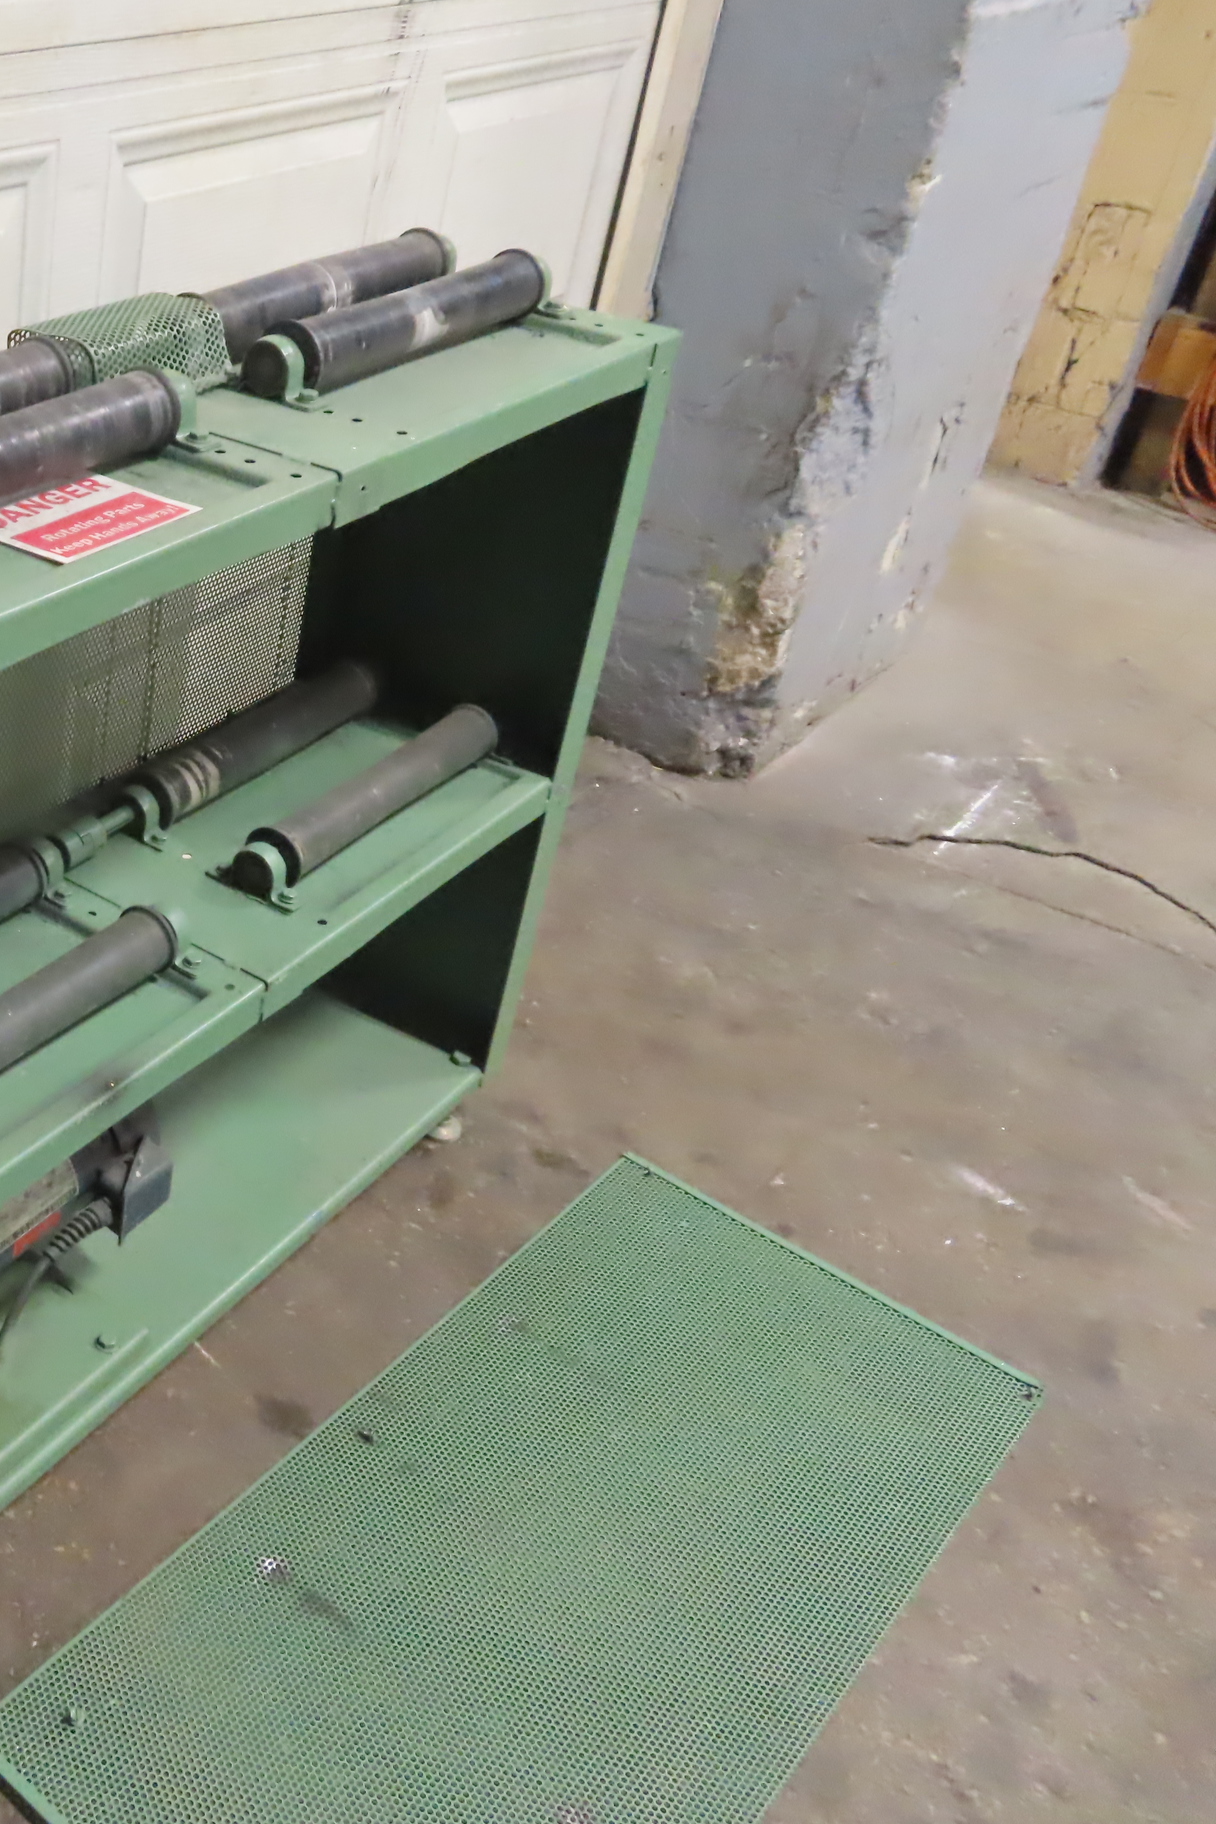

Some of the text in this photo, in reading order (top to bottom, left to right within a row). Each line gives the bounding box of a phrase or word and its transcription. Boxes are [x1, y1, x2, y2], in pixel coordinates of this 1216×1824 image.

[41, 501, 145, 542] Rotating Parts
[50, 504, 179, 556] Keep Hands Away!
